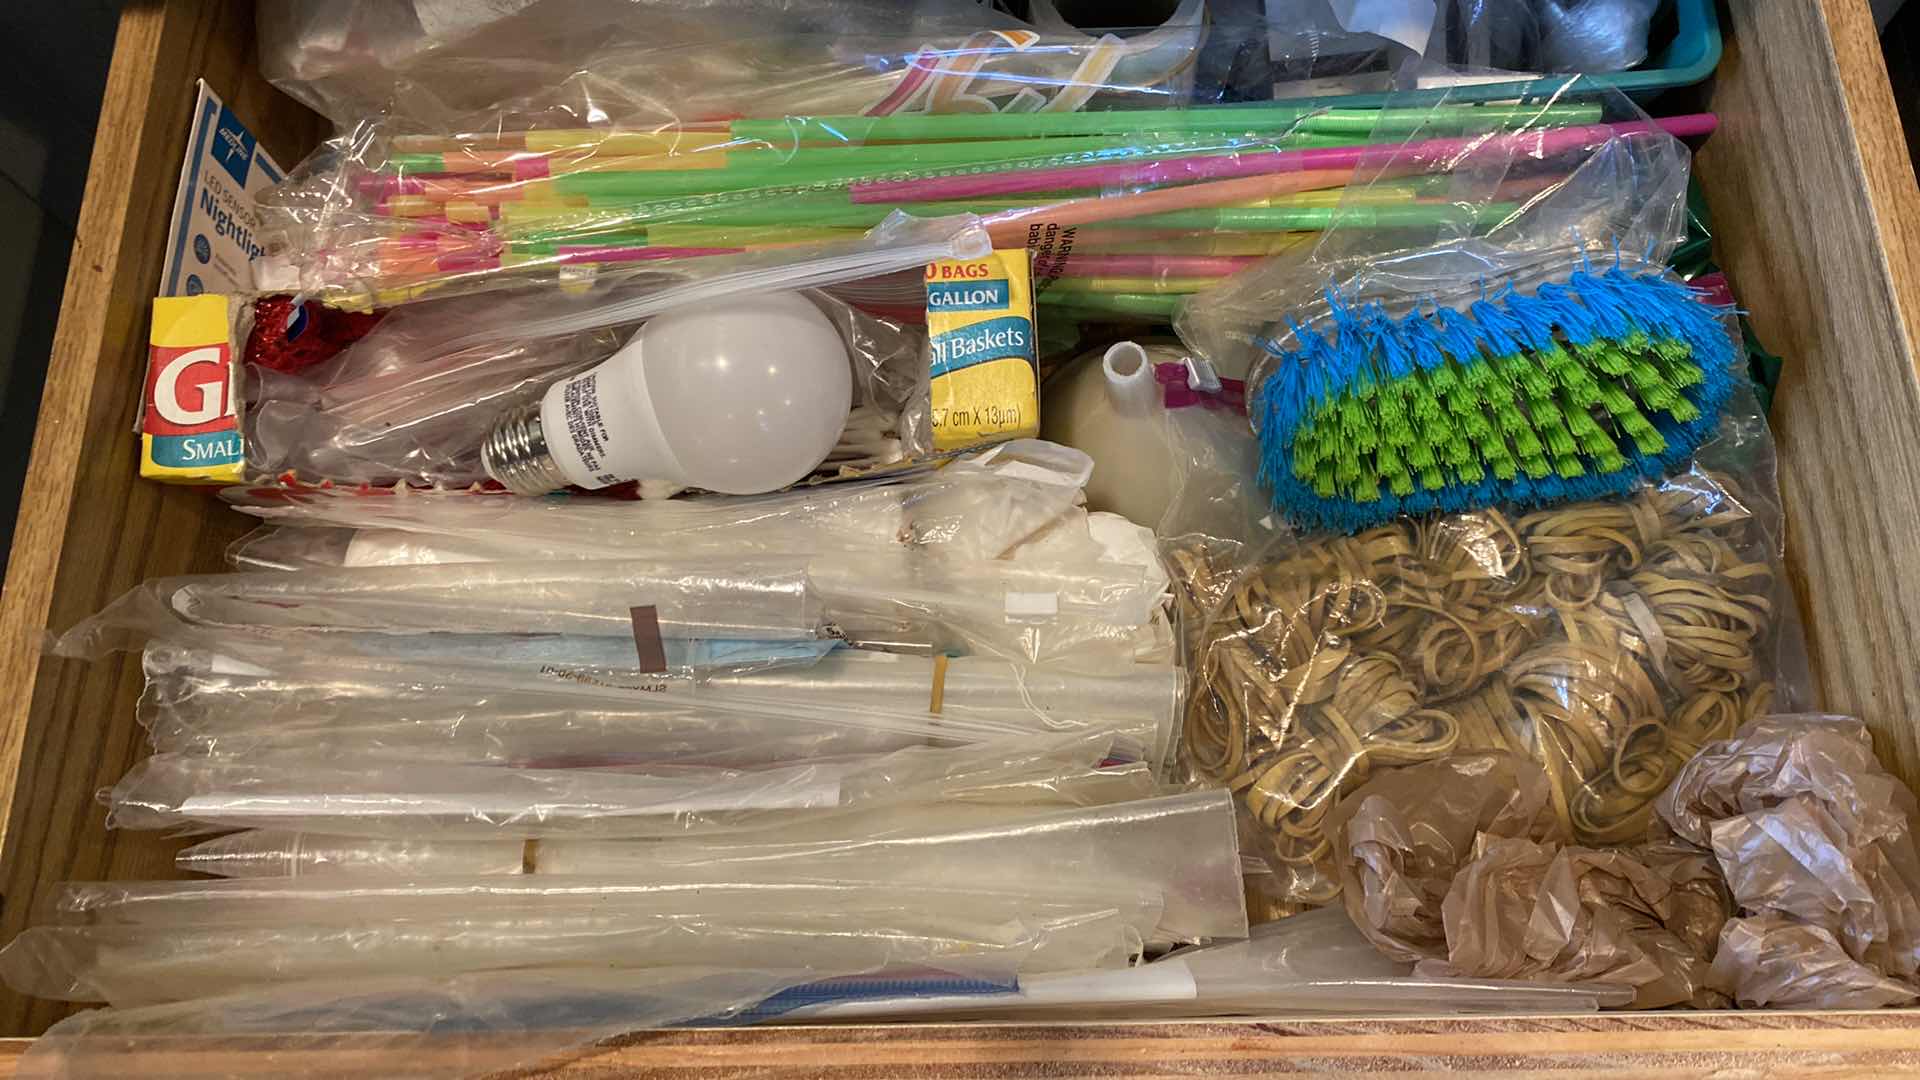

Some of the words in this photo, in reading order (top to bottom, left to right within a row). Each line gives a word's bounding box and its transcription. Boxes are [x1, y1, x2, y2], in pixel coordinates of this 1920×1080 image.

[204, 170, 222, 195] LED
[223, 187, 256, 226] SENSOR
[942, 264, 989, 278] BAGS
[929, 289, 998, 306] GALLON
[950, 327, 1024, 359] Baskets
[953, 410, 970, 426] cm
[973, 407, 981, 425] X
